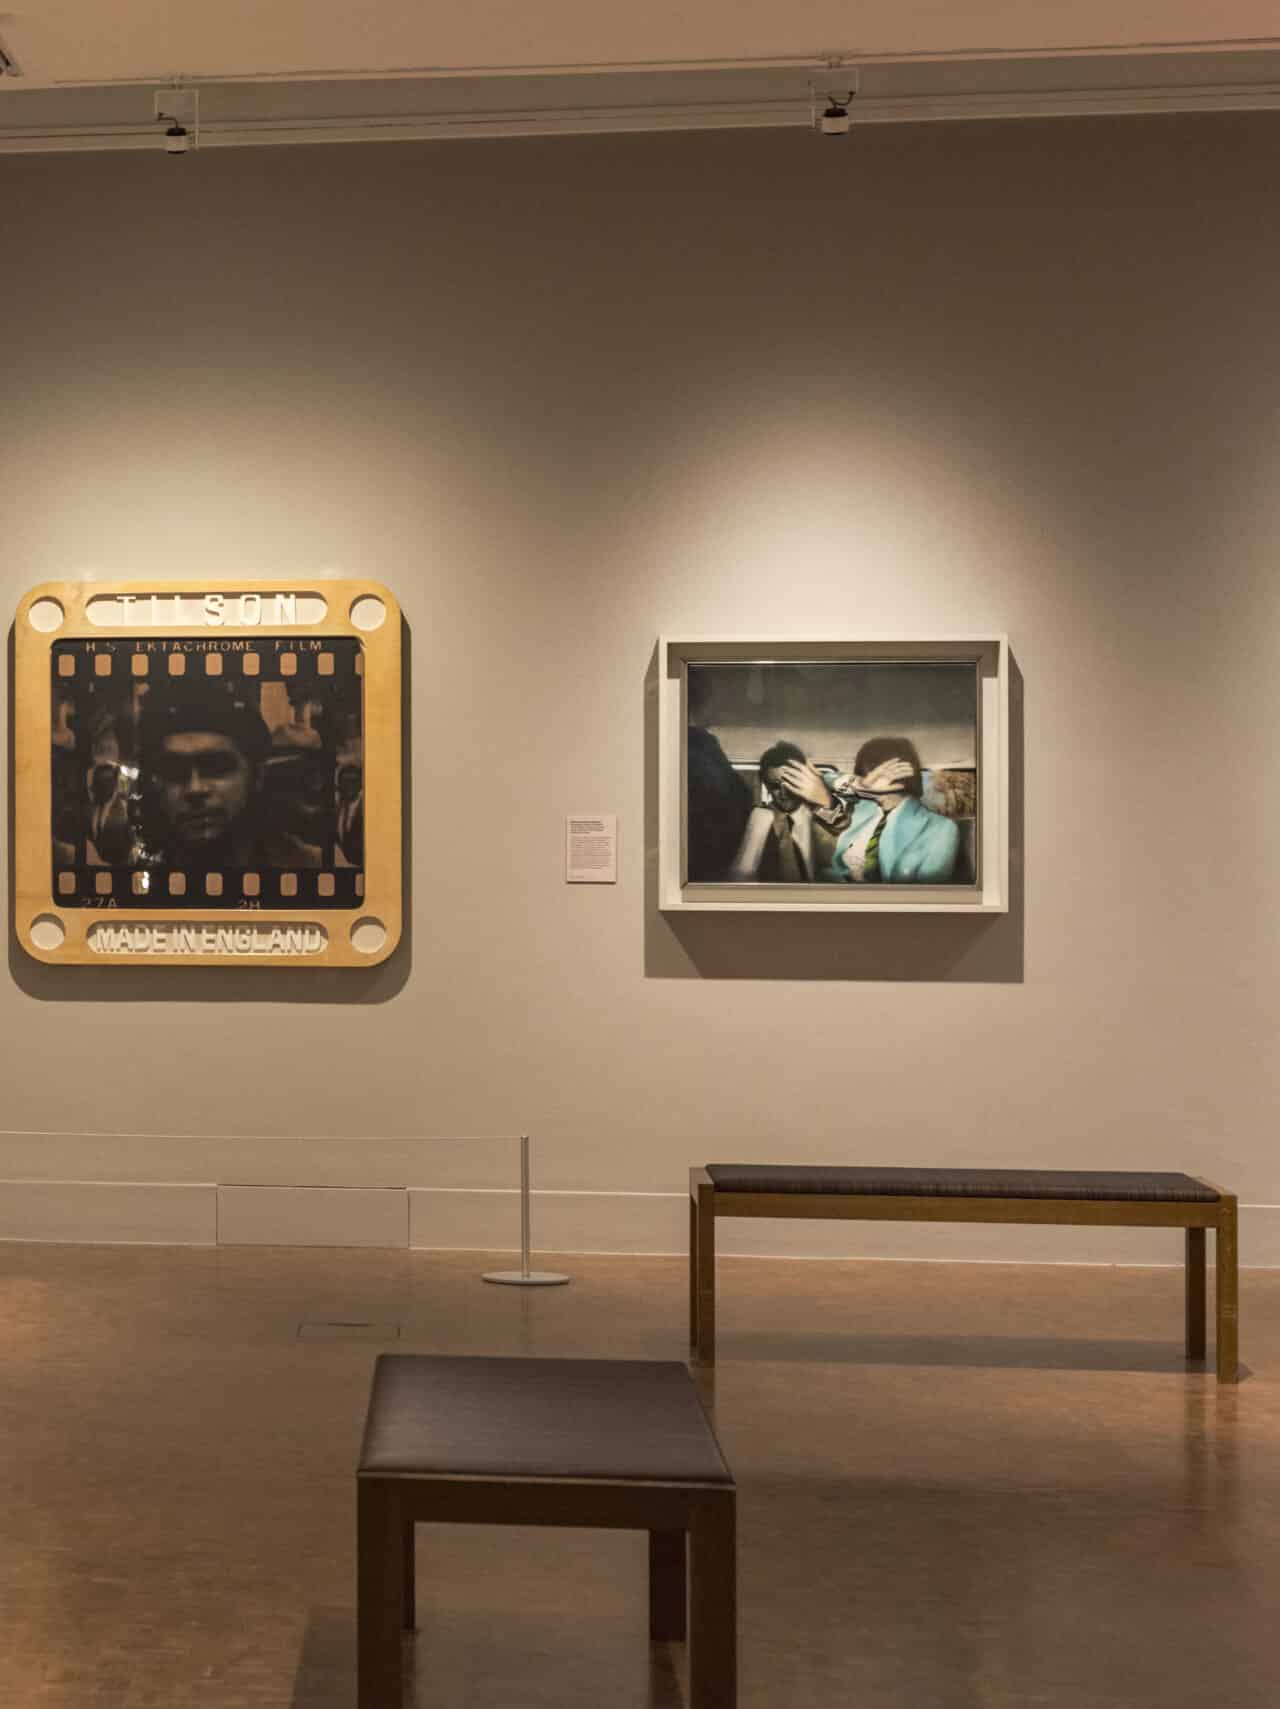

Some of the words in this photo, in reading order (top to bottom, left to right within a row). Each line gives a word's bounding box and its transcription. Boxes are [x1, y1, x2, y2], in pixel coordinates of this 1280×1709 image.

[116, 593, 297, 626] TILSON
[136, 640, 254, 653] EKTACHROME
[274, 640, 322, 653] FILM
[95, 926, 167, 952] MADE
[173, 927, 196, 952] IN
[202, 926, 322, 953] ENGLAND
